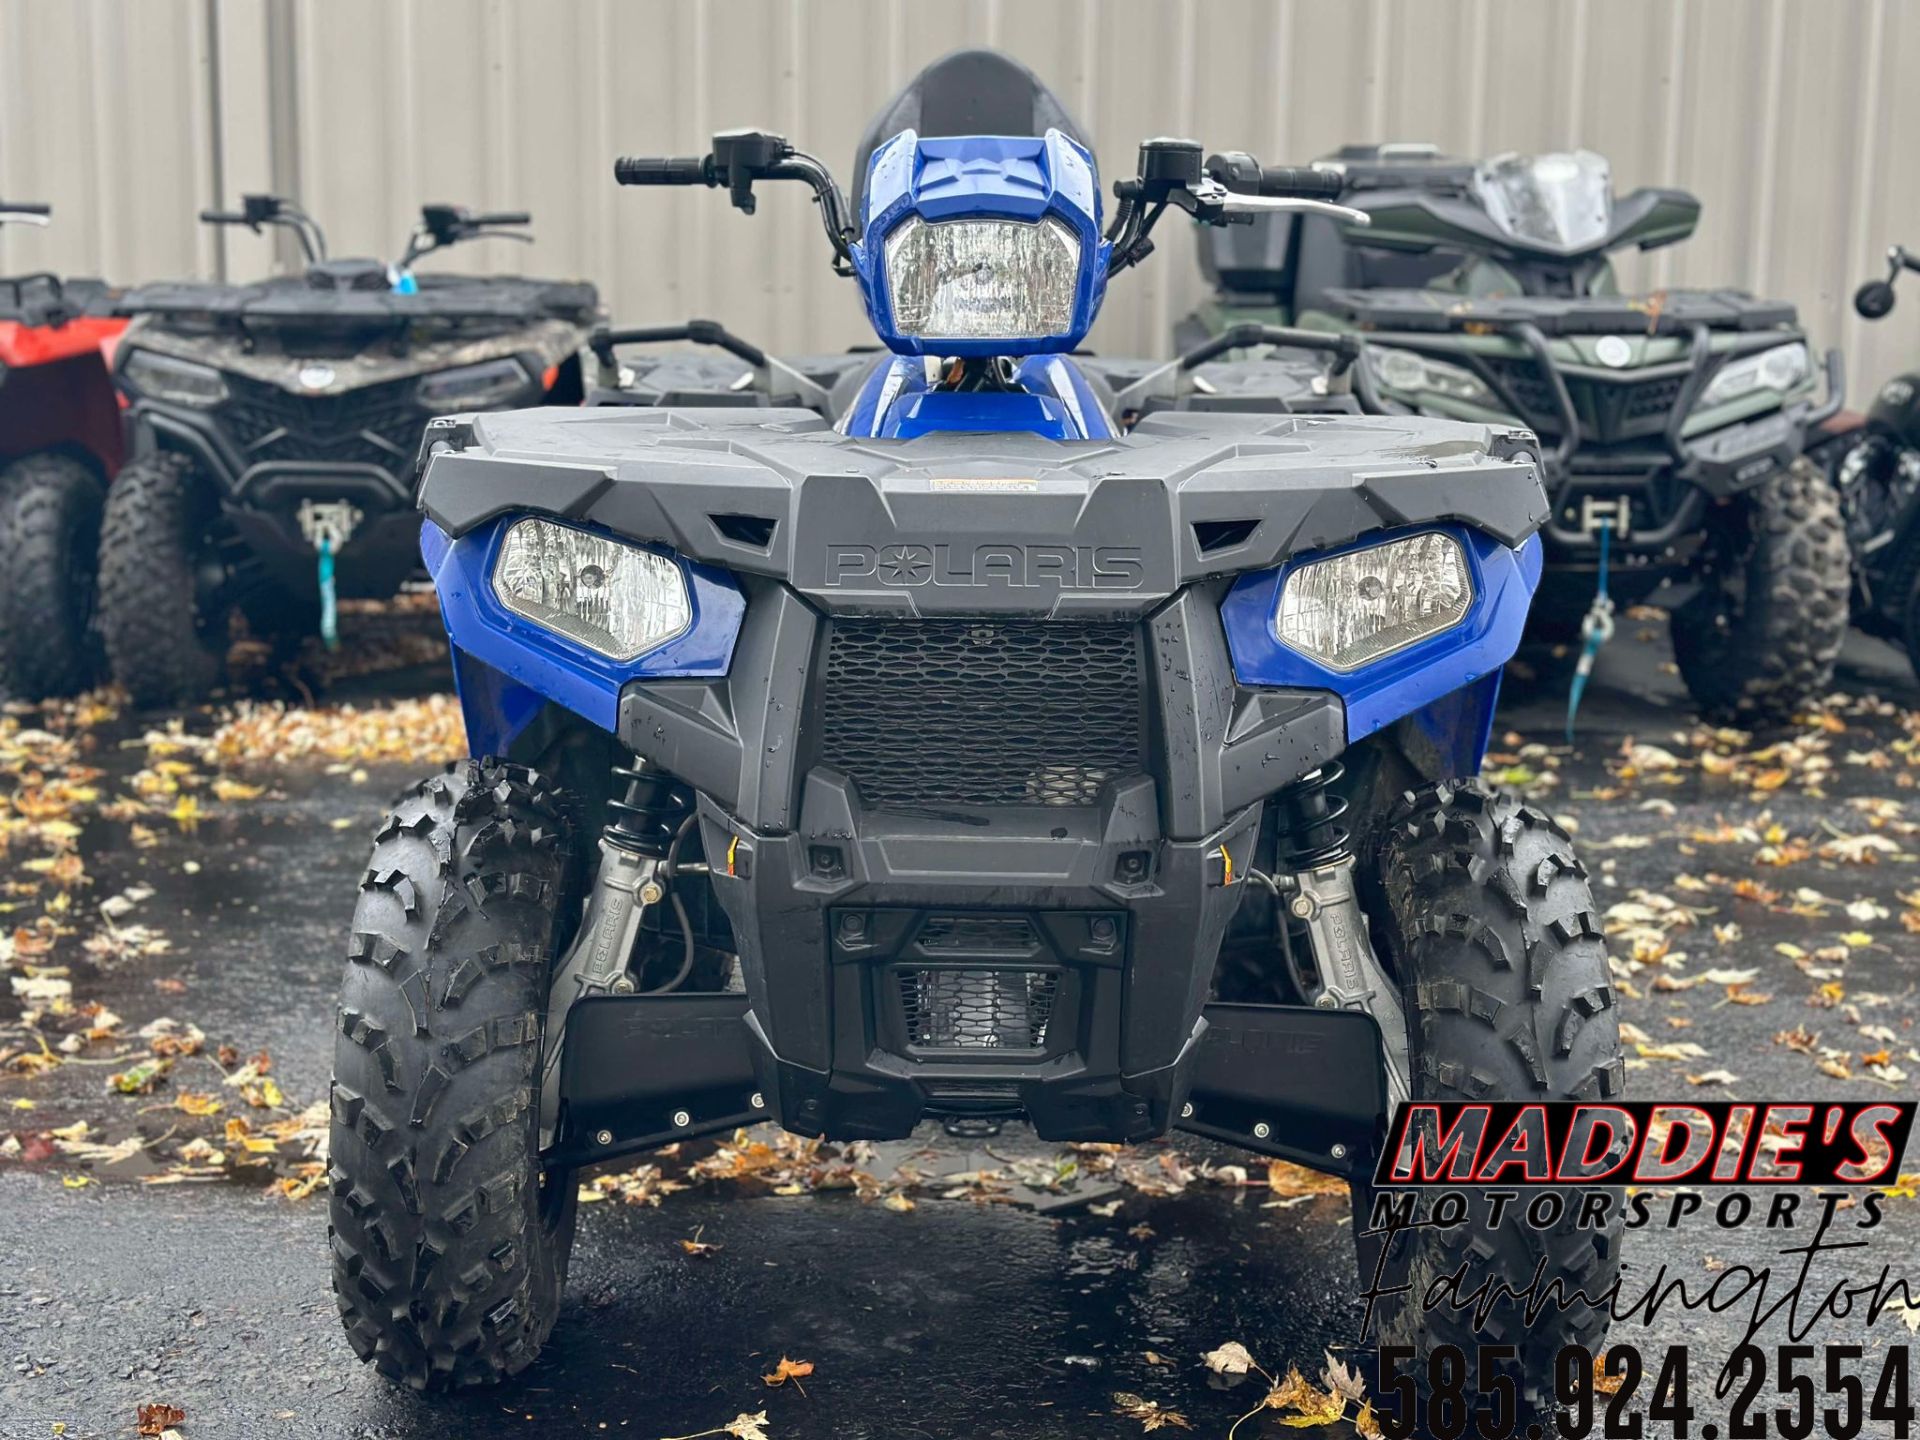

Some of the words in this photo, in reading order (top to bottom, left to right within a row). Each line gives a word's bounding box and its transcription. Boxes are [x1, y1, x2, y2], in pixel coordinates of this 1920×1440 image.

[825, 544, 1144, 589] POLARIS
[592, 898, 623, 974] POLARIS
[1329, 913, 1360, 989] POLARIS
